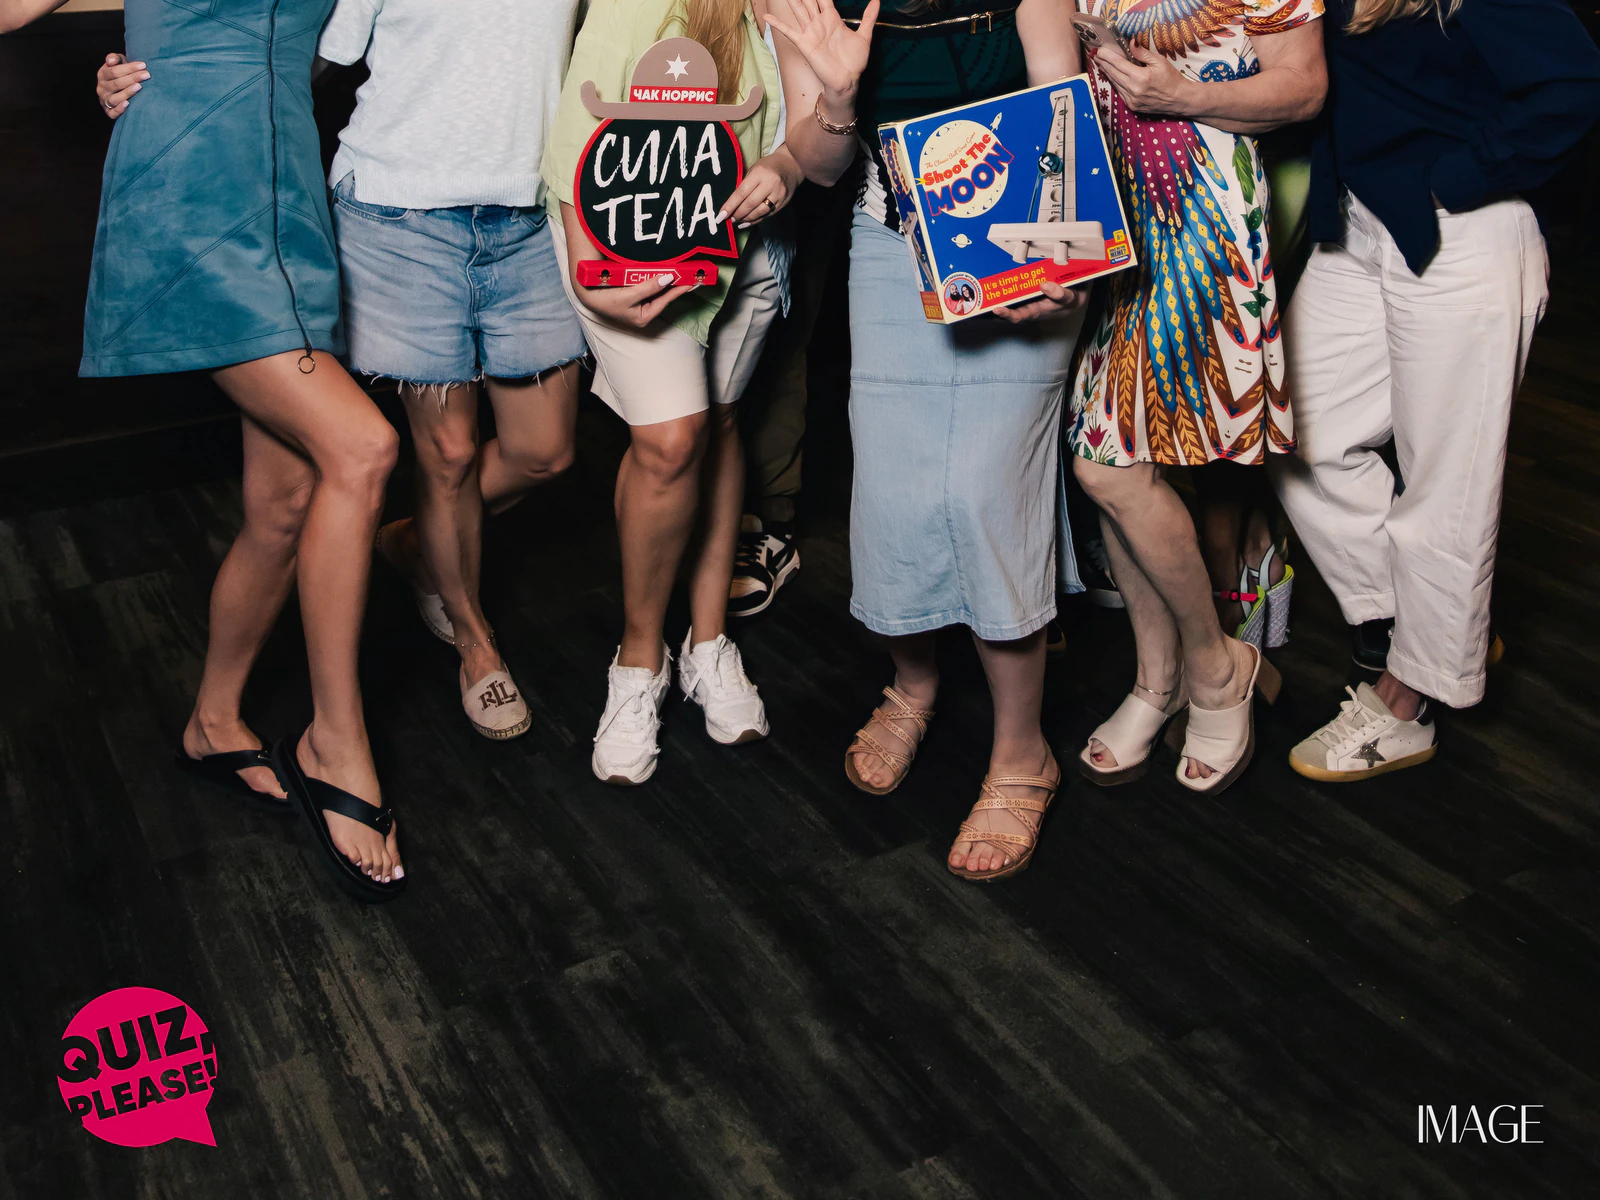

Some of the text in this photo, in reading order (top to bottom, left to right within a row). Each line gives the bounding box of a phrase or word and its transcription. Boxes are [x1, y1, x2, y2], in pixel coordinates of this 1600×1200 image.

[633, 88, 715, 103] ЧАК НОРРИС
[593, 123, 721, 188] СИЛА
[923, 133, 991, 186] Shoot The
[925, 141, 1015, 217] MOON
[592, 183, 719, 246] ТЕЛА
[983, 281, 998, 292] It's
[998, 274, 1019, 287] time
[1020, 272, 1030, 280] to
[1030, 266, 1046, 279] get
[986, 291, 1001, 301] the
[1002, 284, 1019, 296] ball
